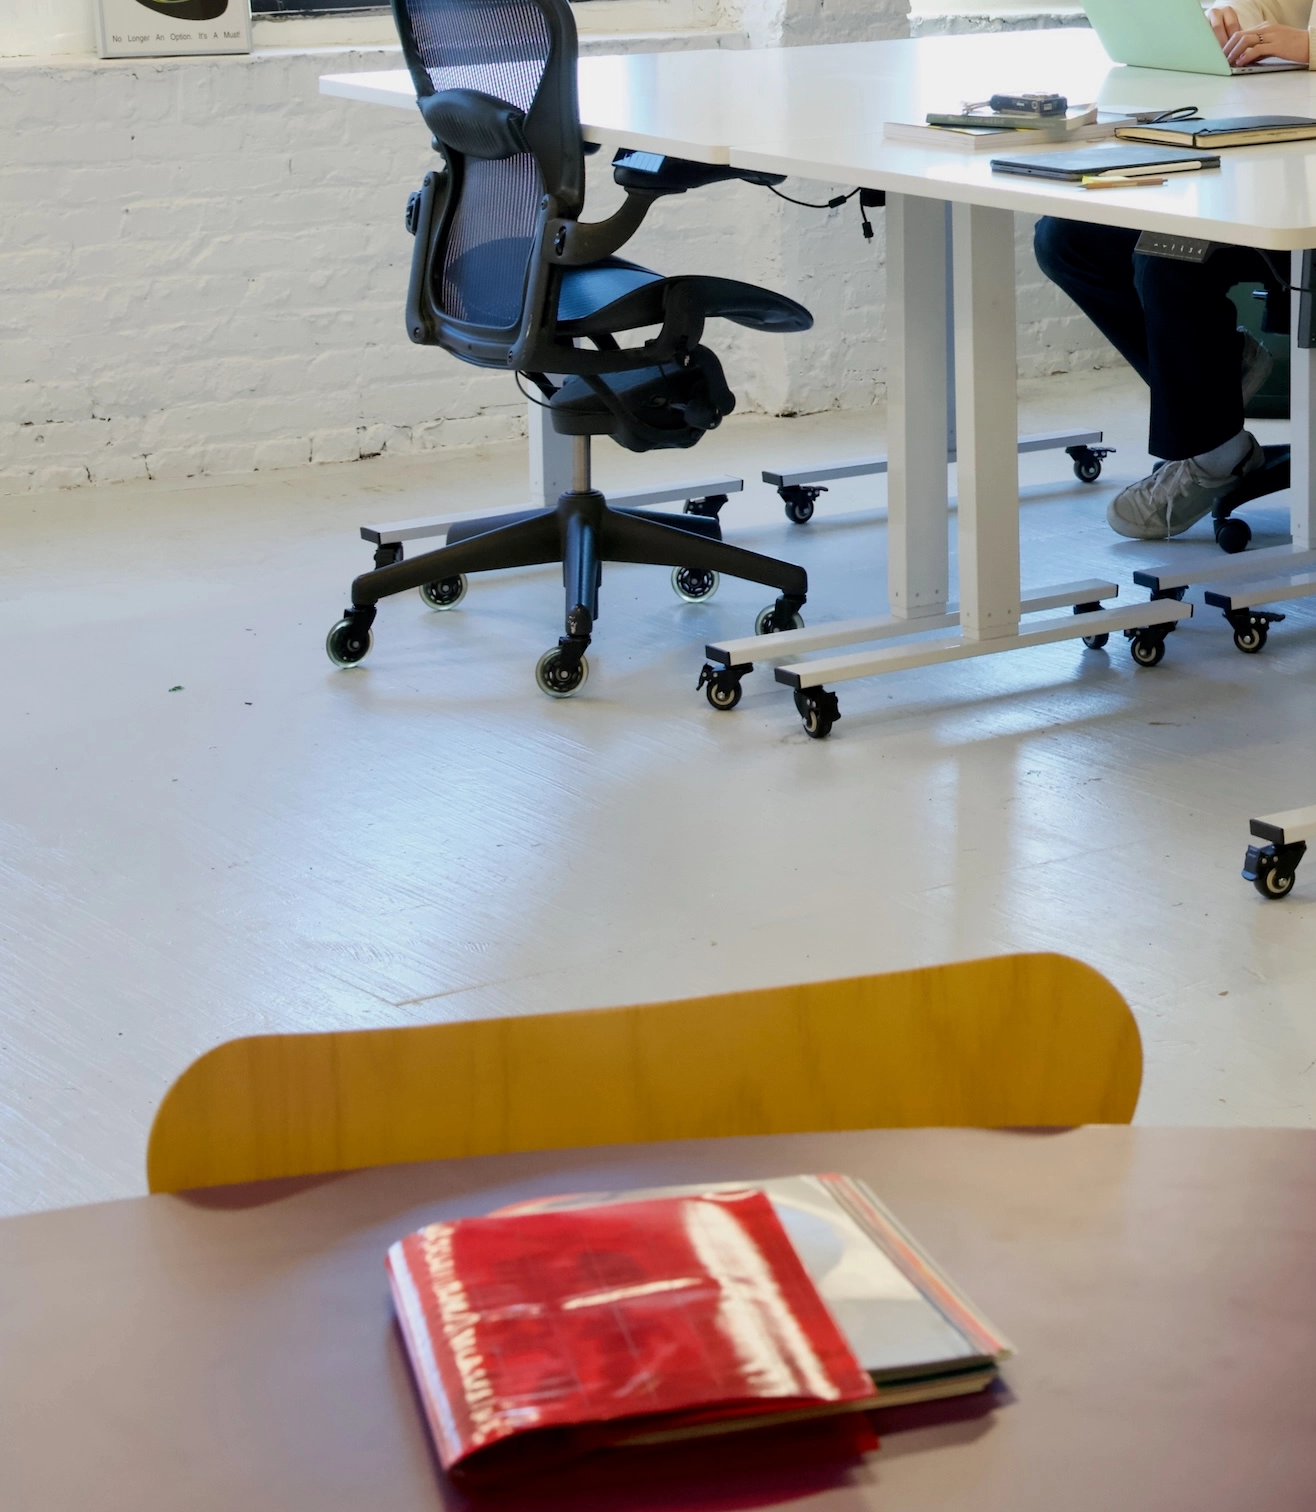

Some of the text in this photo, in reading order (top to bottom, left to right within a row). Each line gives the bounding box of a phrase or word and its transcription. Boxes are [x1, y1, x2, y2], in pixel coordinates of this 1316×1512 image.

[127, 35, 150, 43] Longer
[170, 33, 192, 42] Option.
[198, 32, 208, 40] It's
